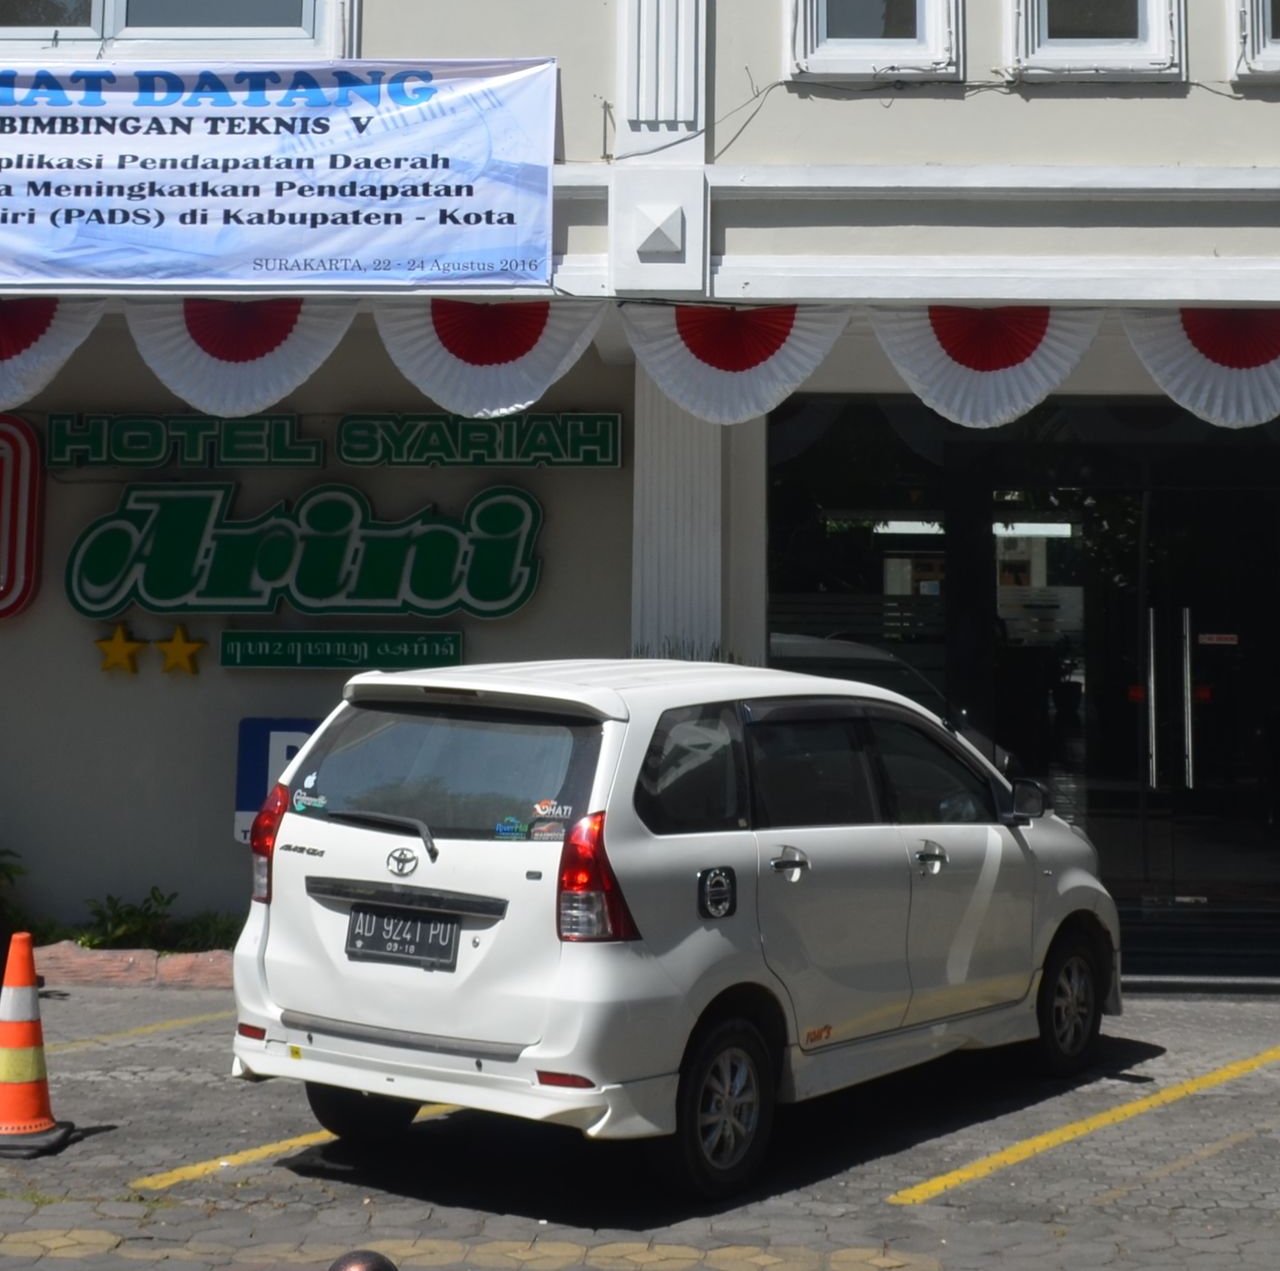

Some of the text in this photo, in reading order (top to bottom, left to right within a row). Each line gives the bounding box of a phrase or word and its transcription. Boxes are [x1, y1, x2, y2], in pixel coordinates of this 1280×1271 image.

[132, 70, 438, 107] DATANG
[204, 116, 330, 135] TEKNIS
[351, 116, 374, 134] V
[118, 154, 315, 173] Pendapatan
[328, 153, 450, 170] Daerah
[26, 180, 261, 201] Meningkatkan
[275, 180, 475, 201] Pendapatan
[50, 207, 165, 229] (PADS)
[178, 208, 208, 225] di
[222, 208, 403, 229] Kabupaten
[438, 208, 517, 225] Kota
[253, 258, 367, 273] SURAKARTA,
[373, 259, 392, 271] 22
[407, 259, 425, 272] 24
[430, 259, 494, 273] Agustus
[500, 259, 539, 271] 2016
[48, 413, 621, 468] HOTEL SYARIAH
[66, 485, 544, 619] Arini
[382, 918, 421, 943] 9241
